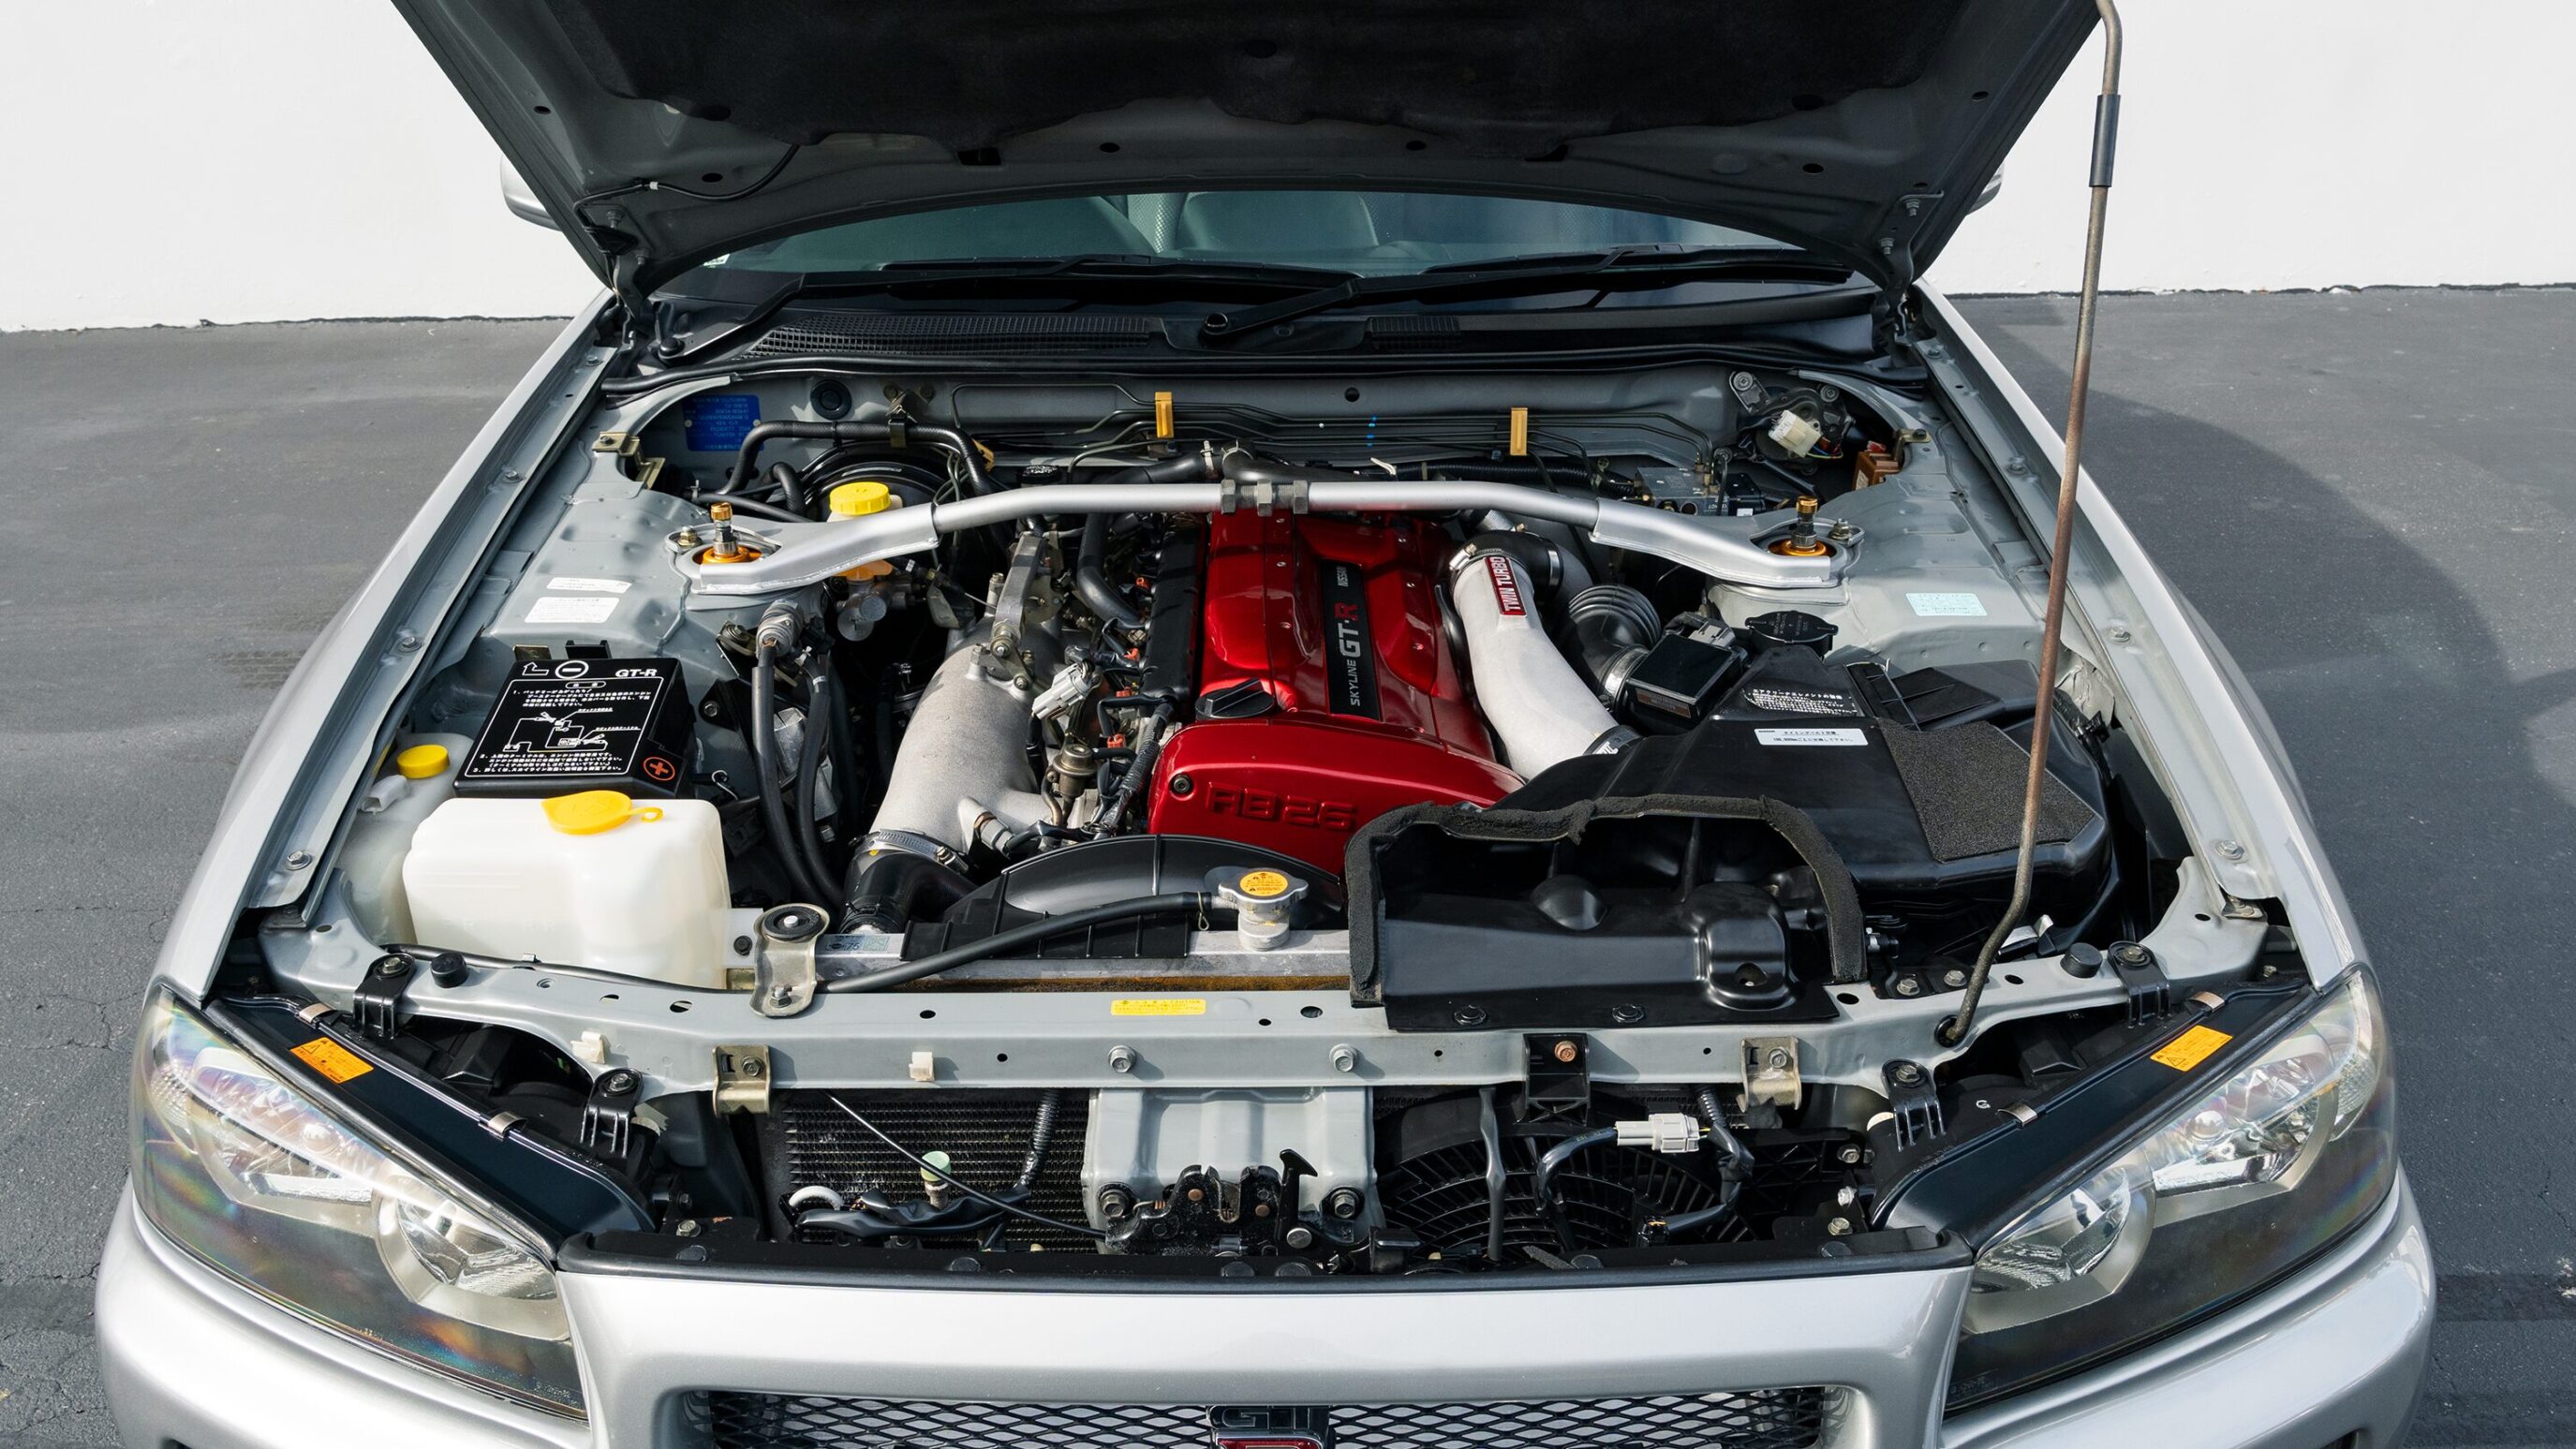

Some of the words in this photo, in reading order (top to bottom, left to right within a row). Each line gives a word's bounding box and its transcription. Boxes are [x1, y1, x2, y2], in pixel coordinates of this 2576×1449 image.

[1489, 556, 1513, 586] TURBO
[1499, 587, 1522, 612] TWIN
[614, 668, 658, 677] GT-R
[1346, 659, 1361, 707] SKYLINE
[1205, 781, 1355, 833] RB26
